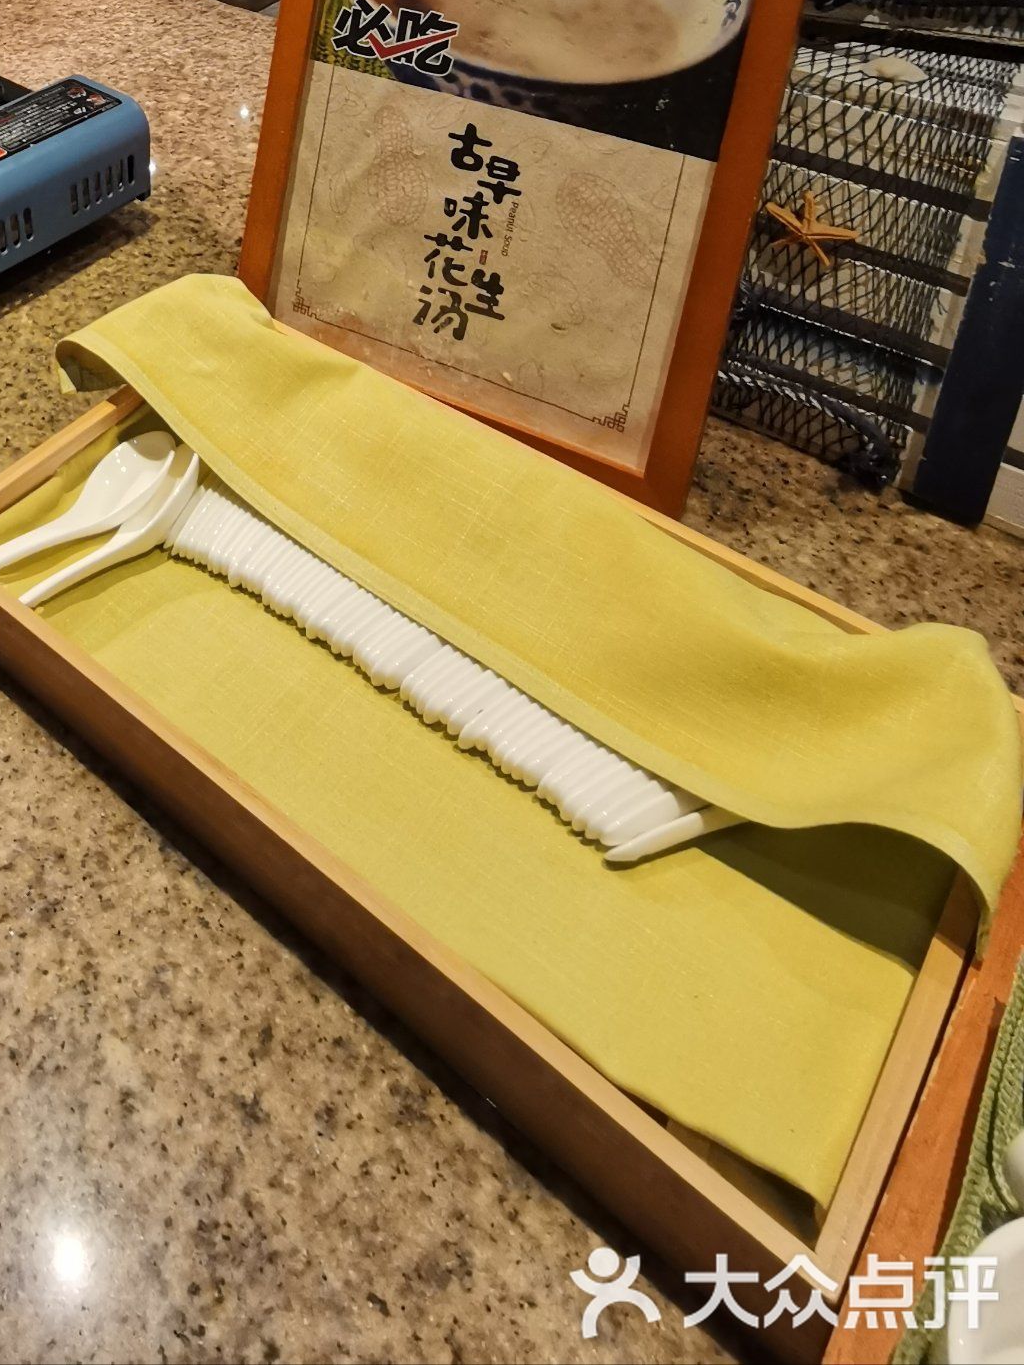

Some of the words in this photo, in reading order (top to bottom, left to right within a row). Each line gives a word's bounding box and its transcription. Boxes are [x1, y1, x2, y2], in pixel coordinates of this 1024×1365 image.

[412, 122, 523, 341] 古早味花生汤
[506, 201, 520, 238] Peanut
[501, 236, 514, 257] Soup
